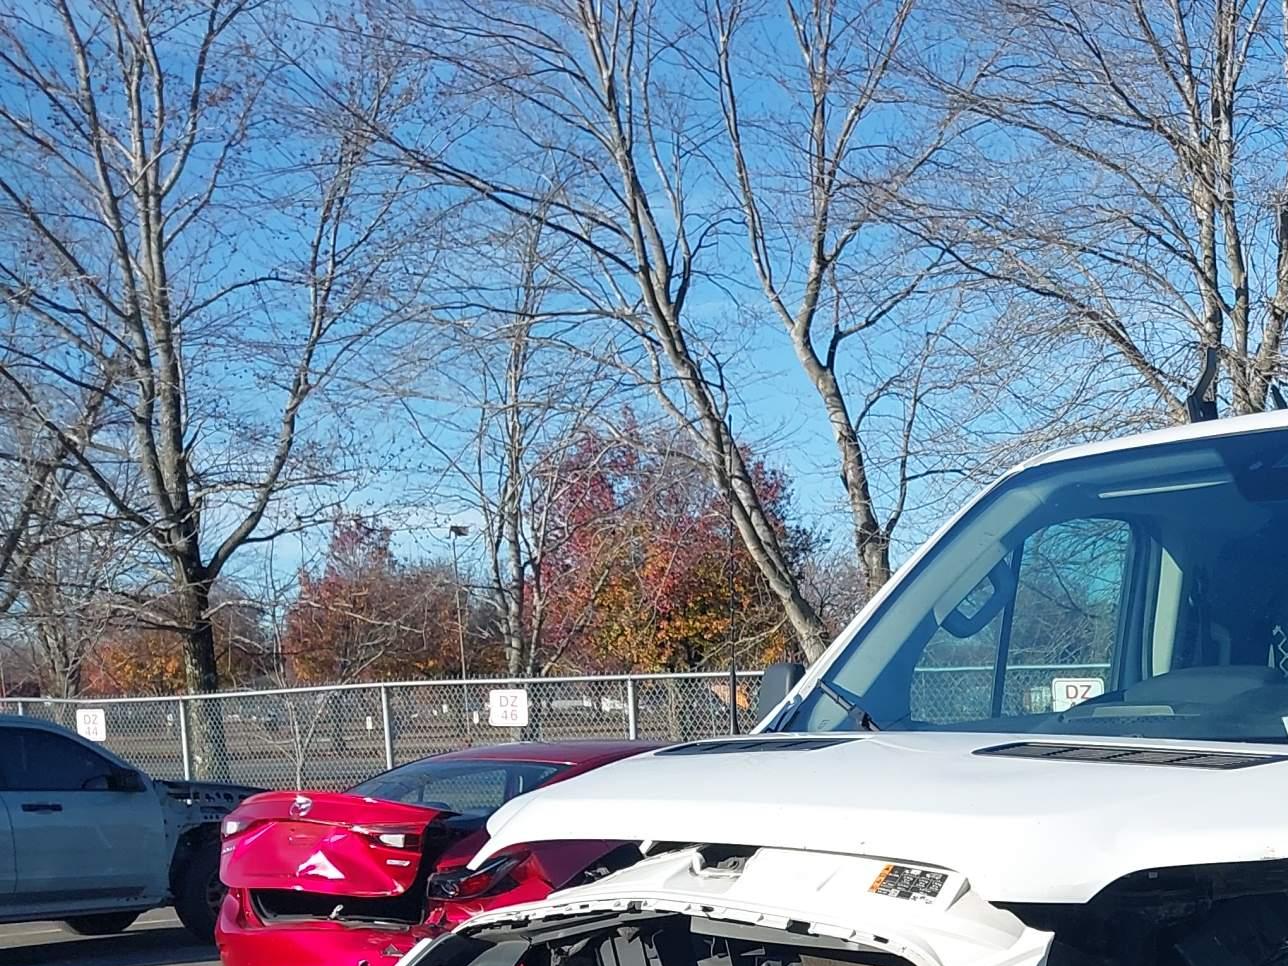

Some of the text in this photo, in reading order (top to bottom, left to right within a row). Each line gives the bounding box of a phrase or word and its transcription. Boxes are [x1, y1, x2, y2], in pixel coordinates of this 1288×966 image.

[1065, 684, 1092, 699] DZ
[499, 695, 518, 707] DZ
[83, 713, 98, 725] DZ
